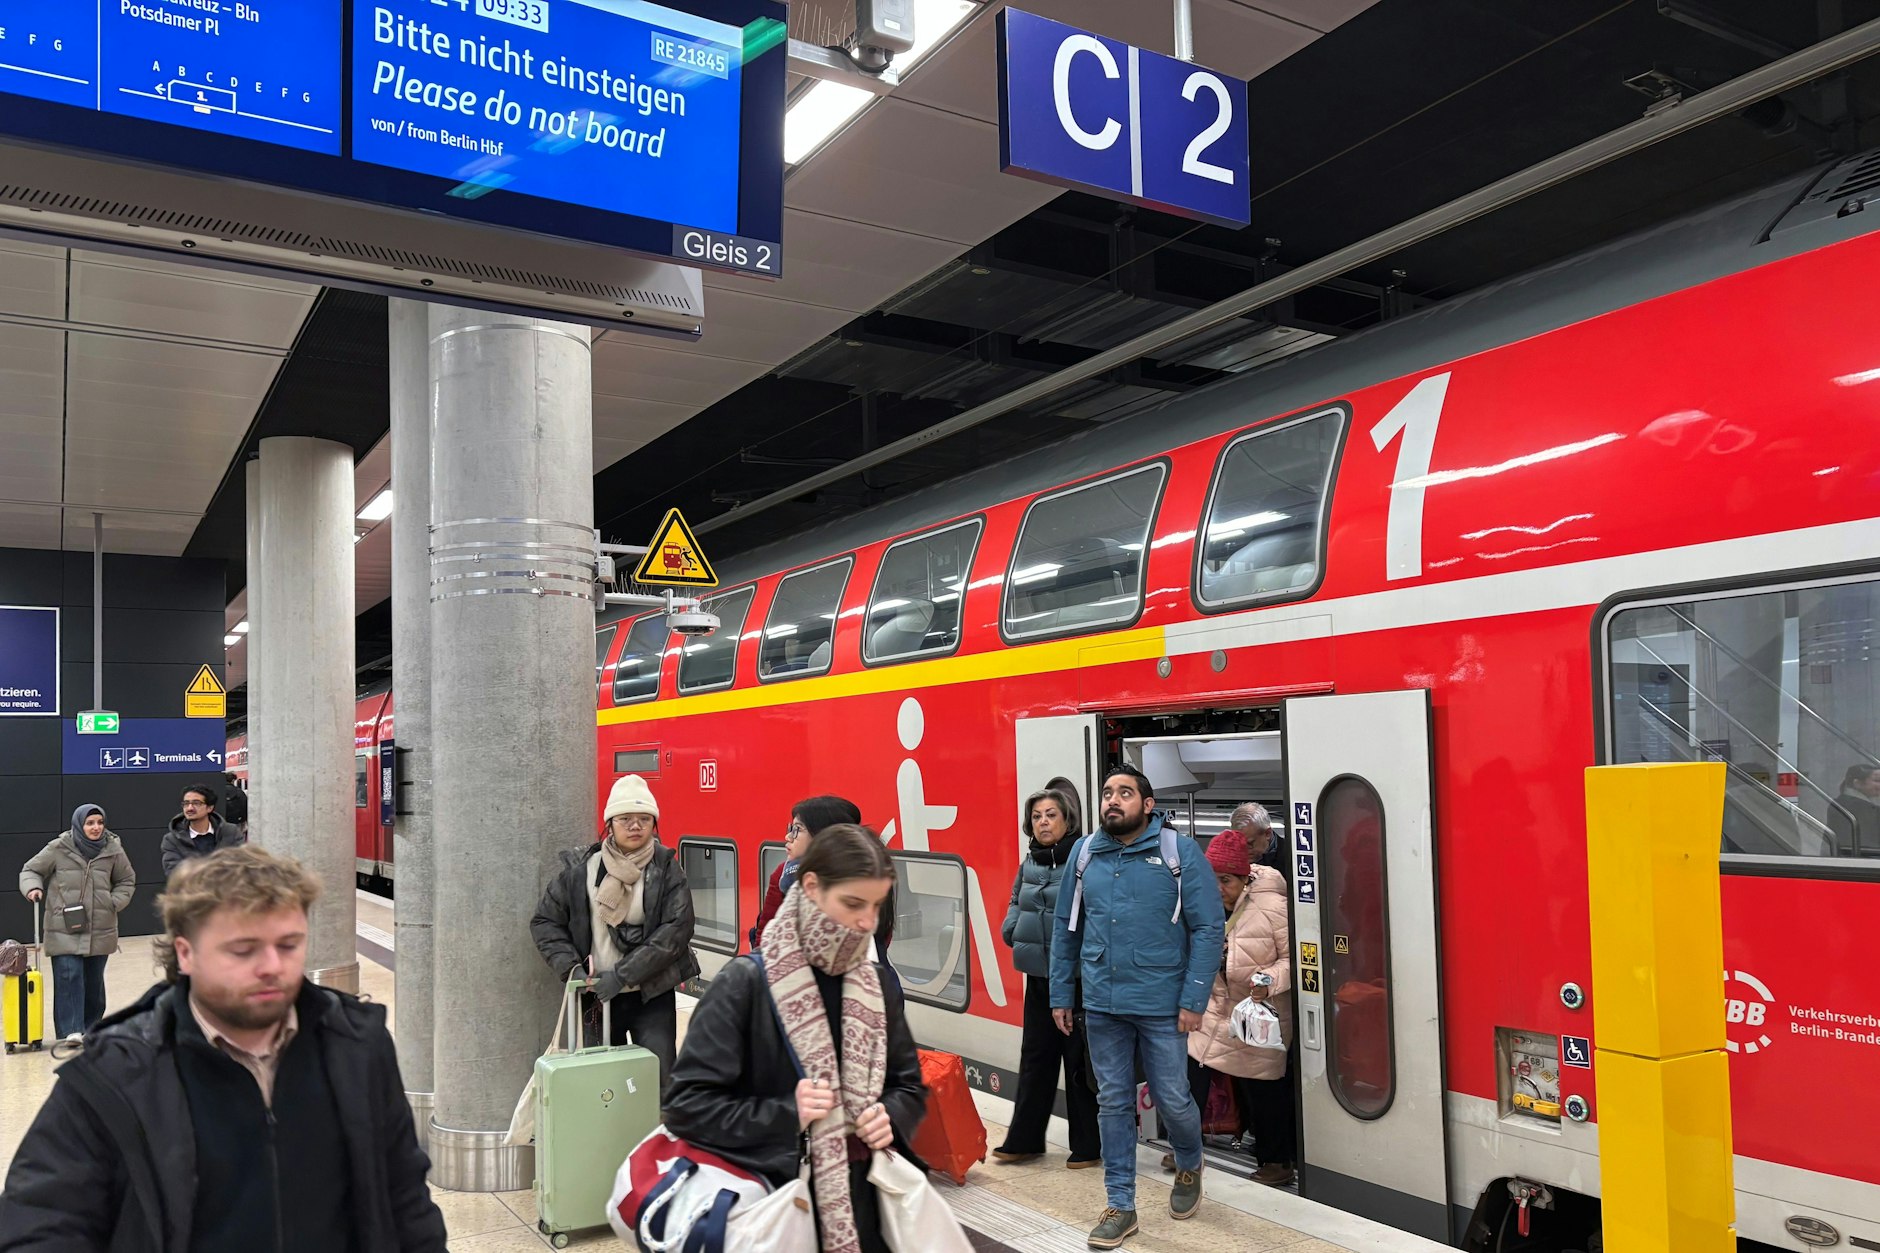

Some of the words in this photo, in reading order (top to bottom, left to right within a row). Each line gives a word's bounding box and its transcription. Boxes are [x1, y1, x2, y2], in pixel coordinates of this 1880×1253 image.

[120, 0, 202, 31] Potsdamer
[205, 18, 220, 36] Pl
[236, 3, 259, 22] Bln
[483, 0, 541, 24] 09:33
[29, 34, 37, 45] F
[54, 39, 62, 51] G
[655, 39, 674, 59] RE
[677, 46, 725, 72] 21845
[374, 7, 449, 57] Bitte
[460, 36, 533, 80] nicht
[542, 57, 685, 116] einsteigen
[152, 61, 160, 72] A
[178, 66, 186, 77] B
[206, 71, 213, 83] C
[230, 76, 238, 88] D
[255, 82, 262, 93] E
[281, 87, 288, 98] F
[302, 92, 310, 103] G
[373, 61, 476, 115] Please
[485, 90, 521, 125] do
[529, 107, 578, 139] not
[585, 111, 666, 158] board
[1053, 34, 1122, 150] C
[1181, 71, 1234, 185] 2
[371, 119, 394, 134] von
[407, 123, 437, 142] from
[440, 130, 477, 151] Berlin
[481, 139, 504, 157] Hbf
[683, 231, 747, 266] Gleis
[756, 246, 772, 270] 2
[1369, 371, 1452, 580] 1
[0, 687, 41, 697] tzieren.
[12, 700, 41, 708] require.
[154, 752, 202, 763] Terminals
[701, 765, 715, 787] DB
[1724, 999, 1766, 1026] BB
[1788, 1005, 1880, 1028] Verkehrsverb
[1790, 1022, 1880, 1045] Berlin-Brande
